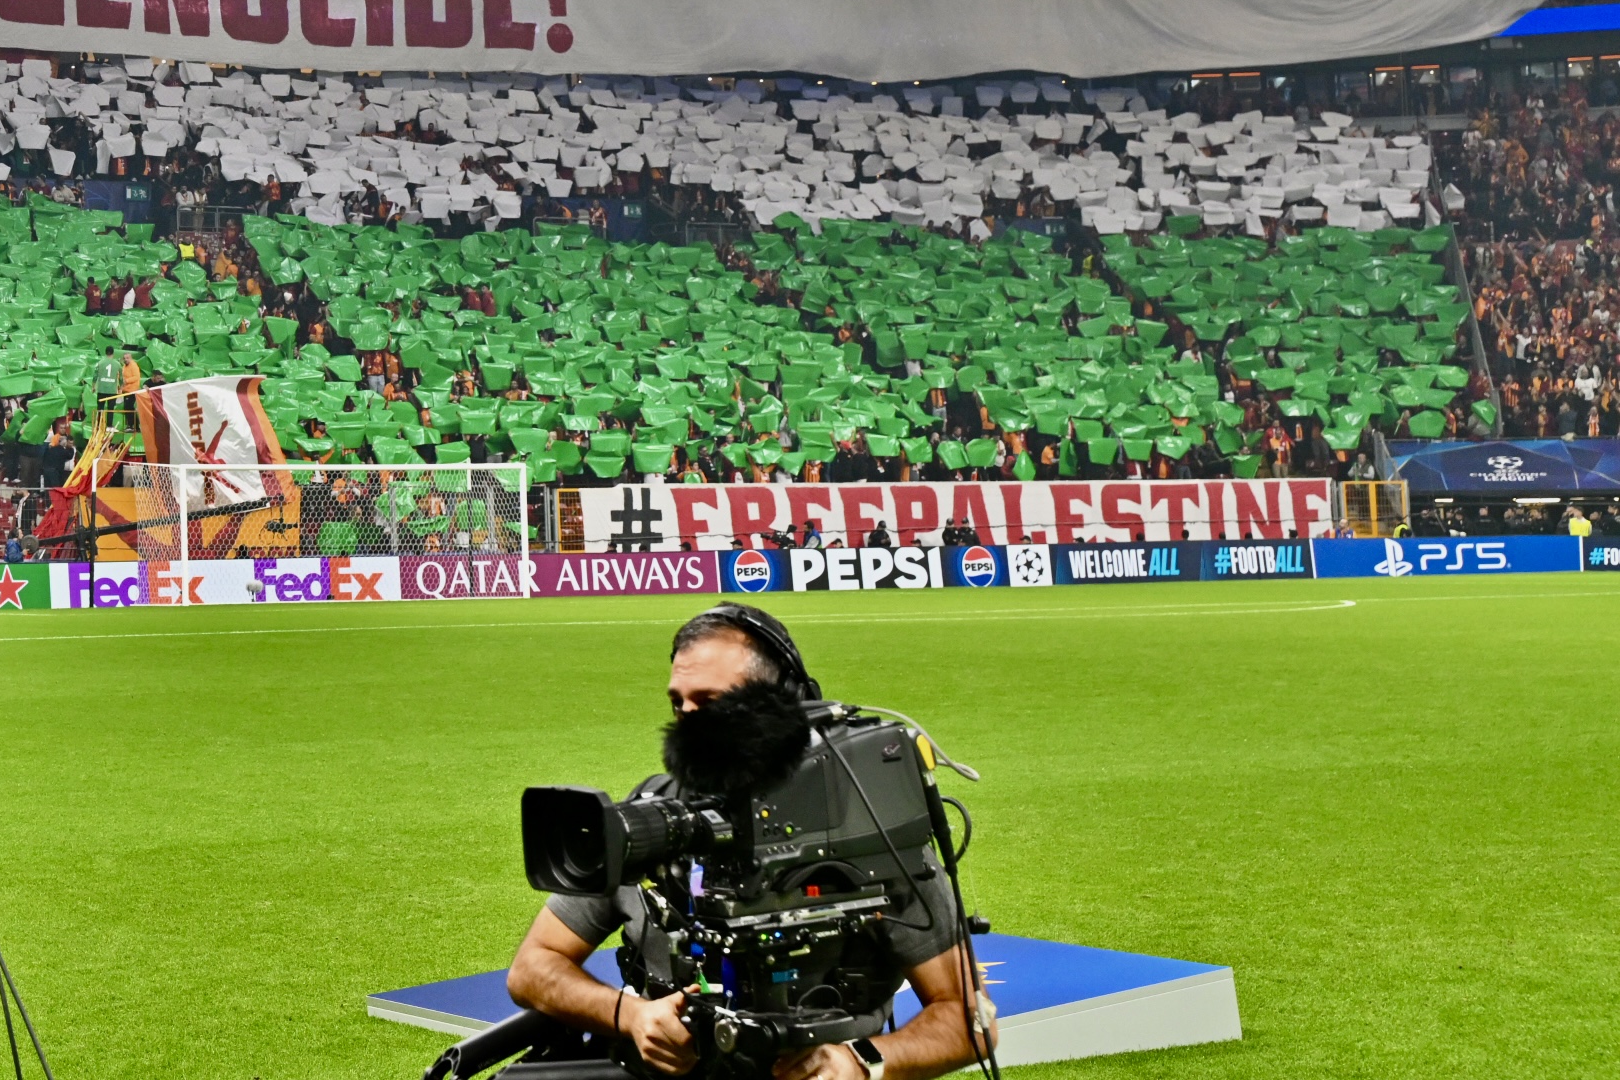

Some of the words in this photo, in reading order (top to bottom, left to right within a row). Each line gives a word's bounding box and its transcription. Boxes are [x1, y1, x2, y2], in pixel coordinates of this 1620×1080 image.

[105, 363, 112, 378] 1
[610, 479, 1331, 552] #FREEPALESTINE
[736, 566, 768, 577] PEPSI
[790, 546, 944, 593] PEPSI
[964, 561, 994, 572] PEPSI
[1068, 548, 1146, 579] WELCOME
[1148, 547, 1180, 577] ALL
[1213, 545, 1305, 575] #FOOTBALL
[1418, 542, 1507, 570] PS5
[253, 555, 384, 603] FedEx
[555, 555, 705, 593] AIRWAYS
